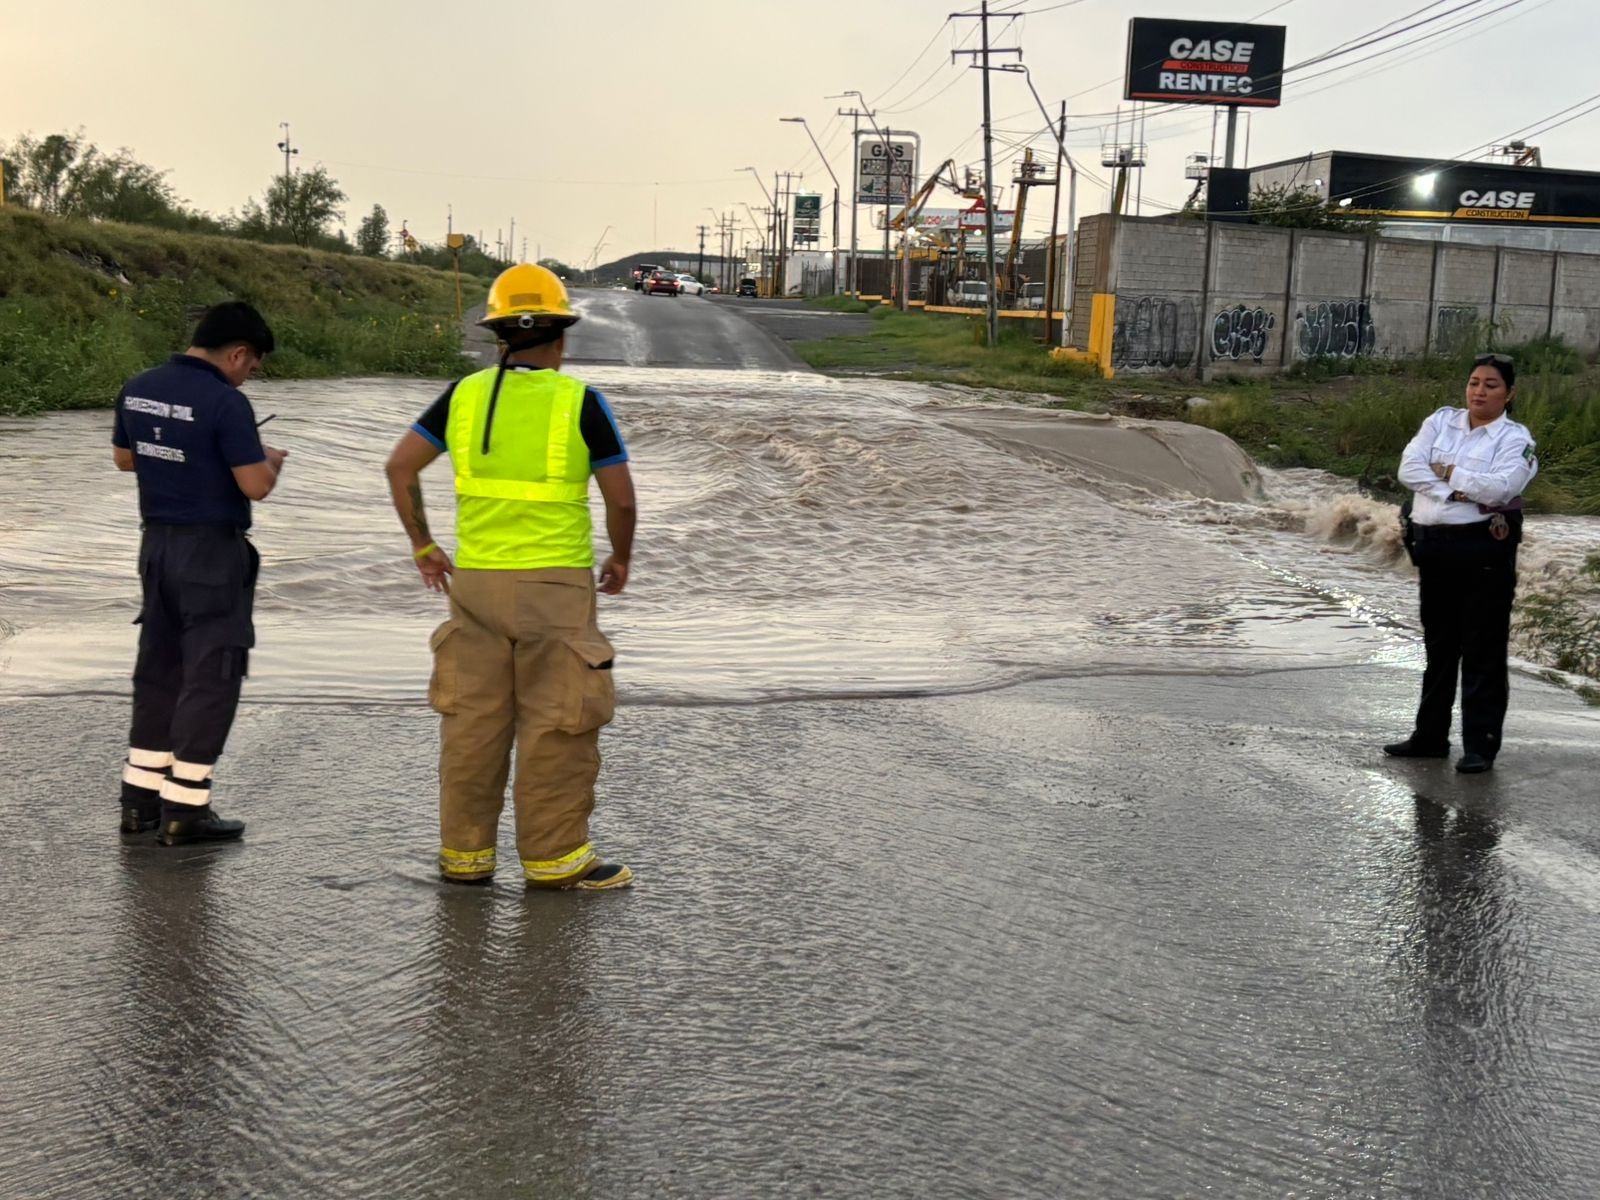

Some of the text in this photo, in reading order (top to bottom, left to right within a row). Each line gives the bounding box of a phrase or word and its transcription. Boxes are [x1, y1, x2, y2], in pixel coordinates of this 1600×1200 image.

[1169, 37, 1254, 62] CASE
[1159, 72, 1253, 94] RENTEC
[1459, 190, 1536, 208] CASE
[1465, 209, 1525, 218] CONSTRUCTION
